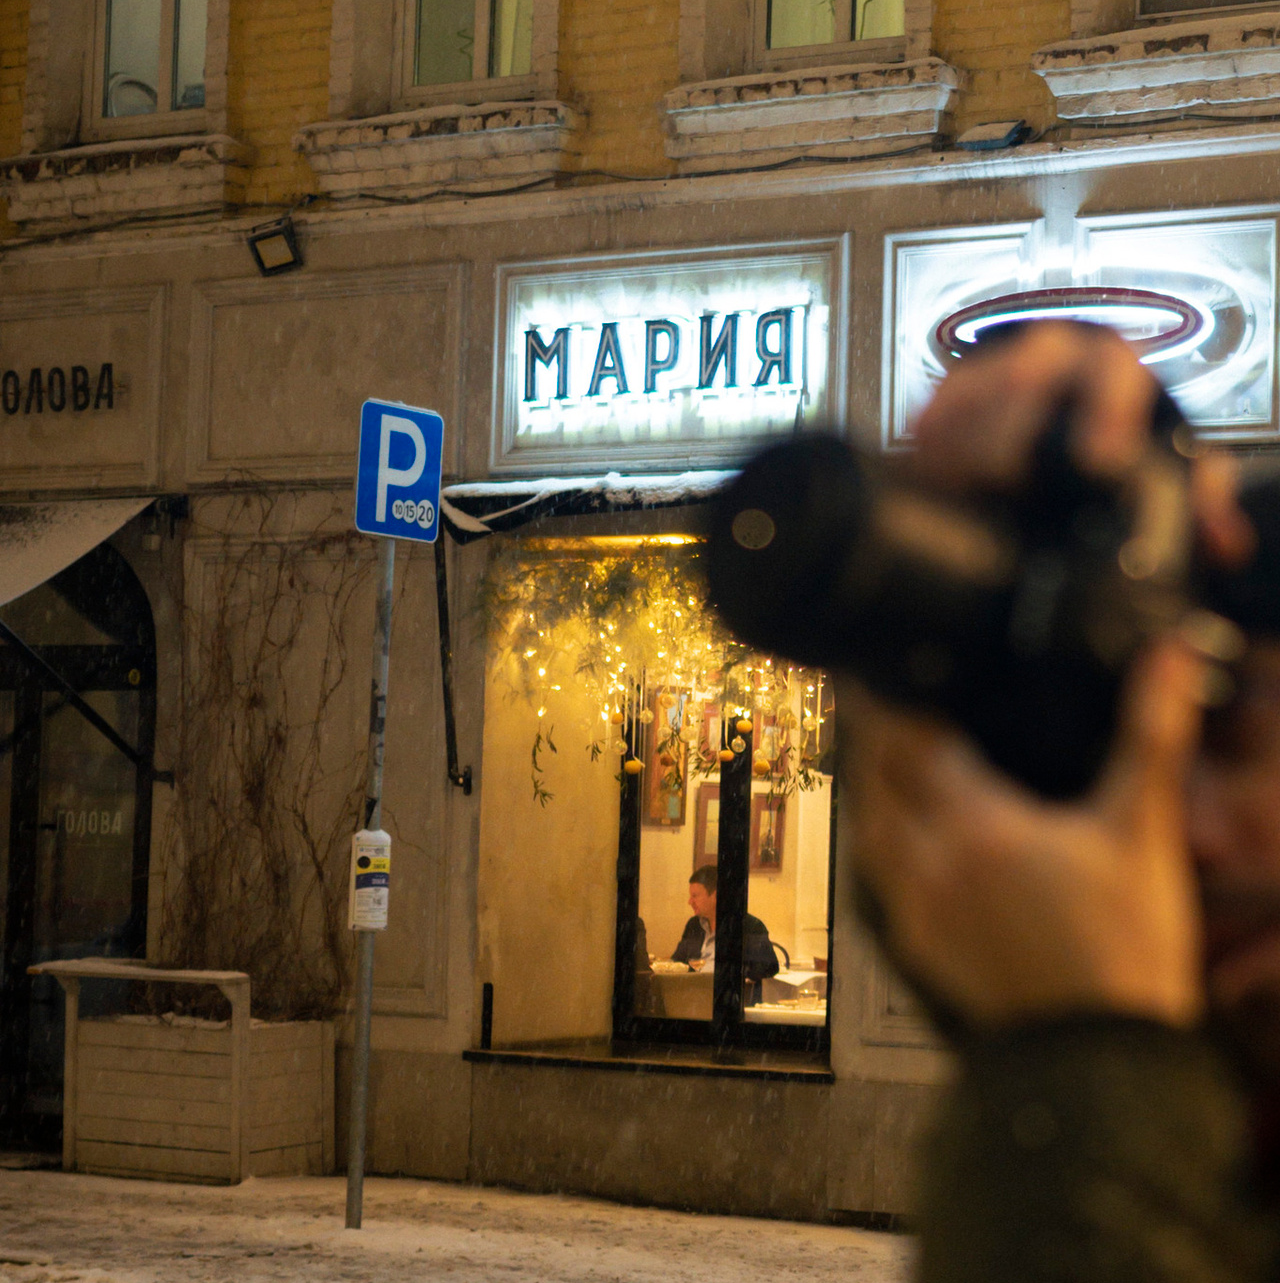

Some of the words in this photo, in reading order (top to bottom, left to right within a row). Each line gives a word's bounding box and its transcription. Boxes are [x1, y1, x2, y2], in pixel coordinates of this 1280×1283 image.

[2, 363, 114, 415] ОЛОВА
[523, 308, 793, 402] МАРИЯ
[375, 413, 427, 523] P
[394, 504, 403, 516] 10
[405, 504, 416, 519] 15
[418, 506, 434, 523] 20
